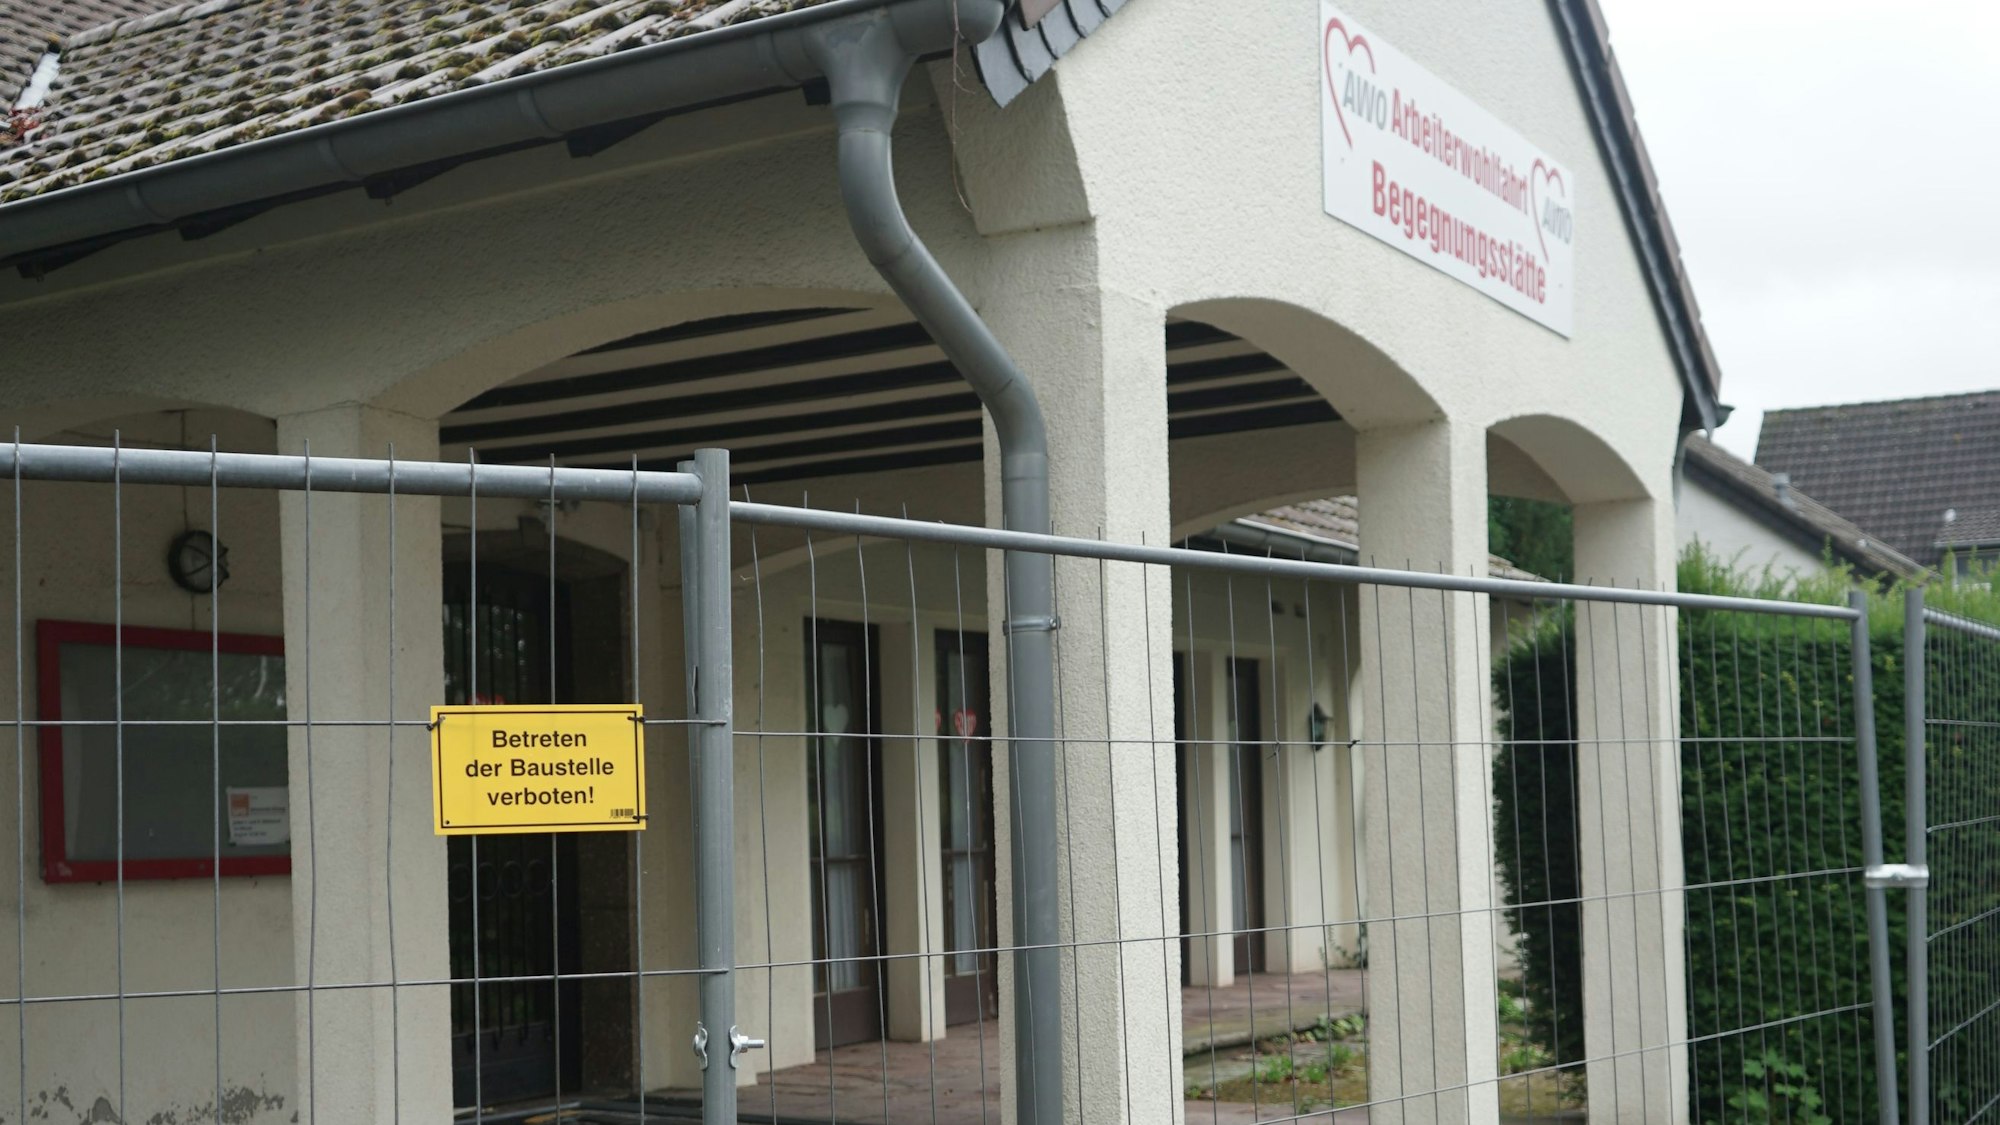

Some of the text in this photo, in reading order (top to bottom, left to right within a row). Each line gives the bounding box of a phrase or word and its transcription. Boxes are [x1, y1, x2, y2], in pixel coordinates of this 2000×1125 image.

[1343, 71, 1573, 244] AWO Arbeiterwohlfahrt AWO
[1372, 160, 1545, 304] Begegnungsstätte
[491, 729, 587, 748] Betreten
[465, 757, 614, 777] der Baustelle
[487, 786, 594, 805] verboten!
